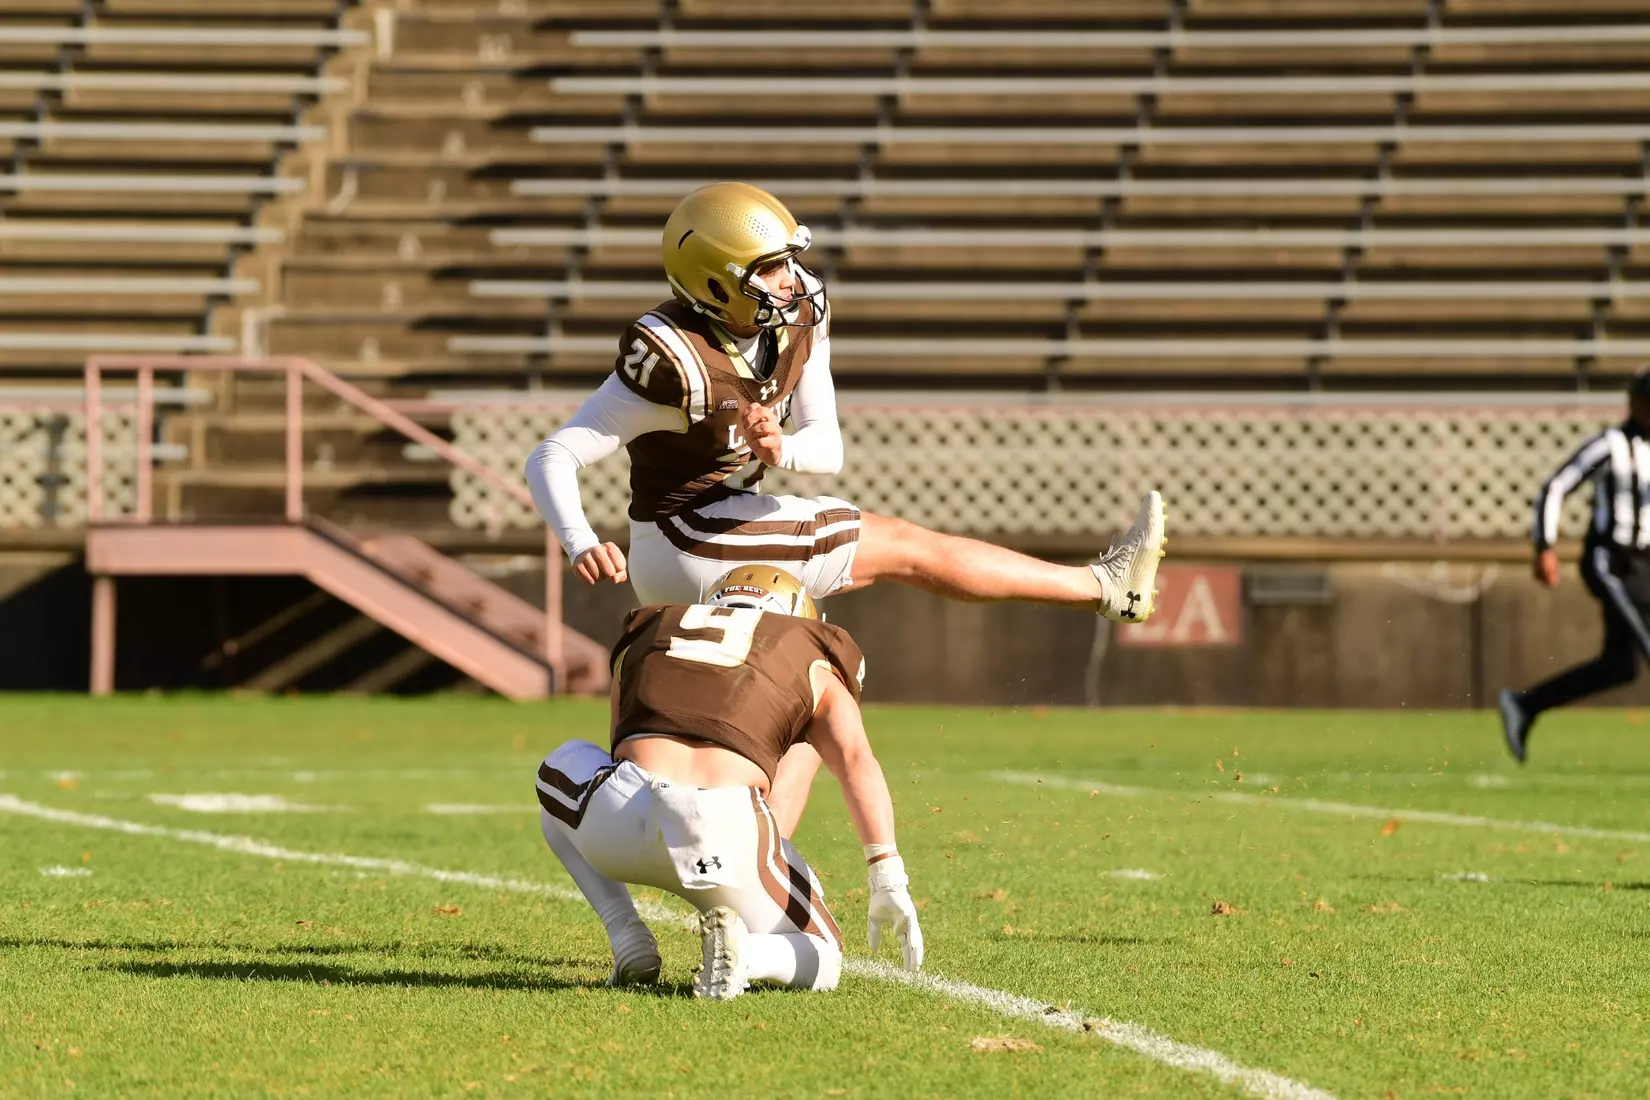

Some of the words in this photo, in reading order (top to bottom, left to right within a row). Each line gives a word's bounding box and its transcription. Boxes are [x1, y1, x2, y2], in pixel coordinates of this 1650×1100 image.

[623, 338, 660, 388] 21
[724, 585, 741, 593] THE
[665, 604, 763, 667] 9
